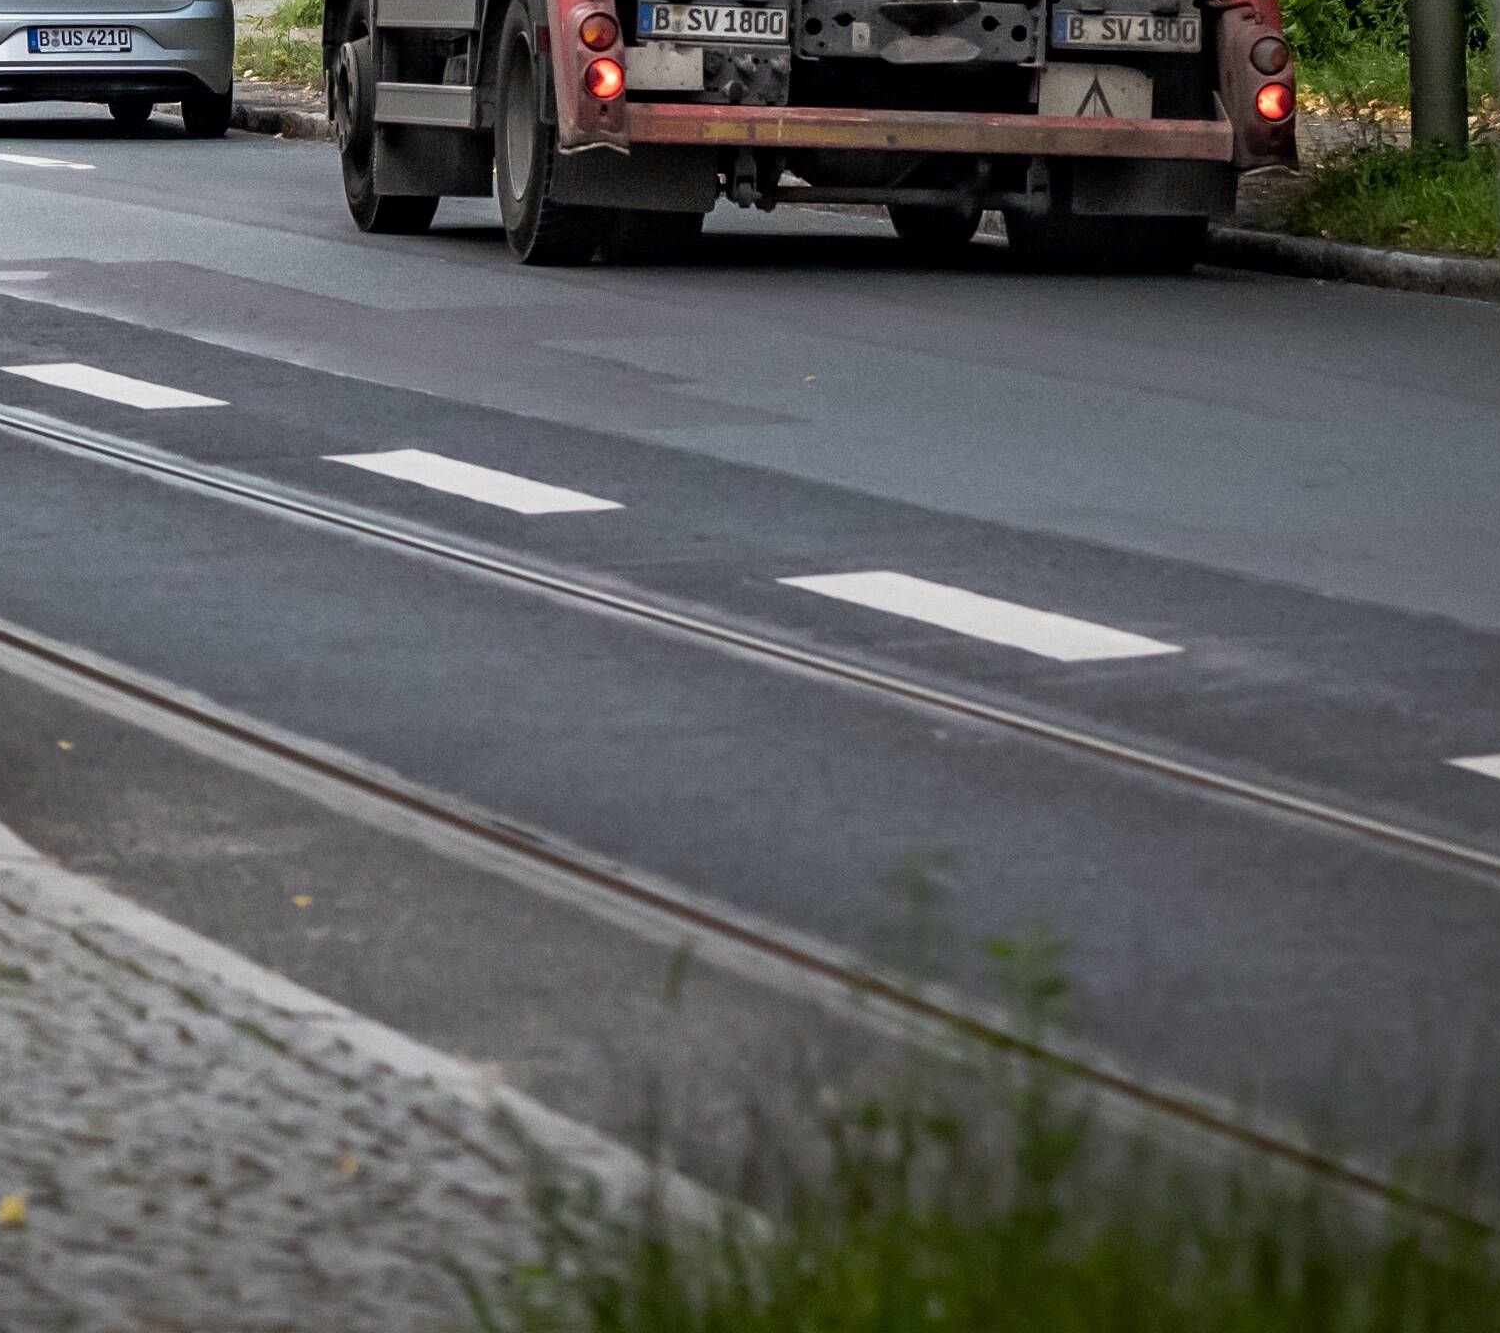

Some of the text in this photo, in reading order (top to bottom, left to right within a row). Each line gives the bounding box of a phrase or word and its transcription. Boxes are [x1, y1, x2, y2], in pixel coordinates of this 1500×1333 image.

[656, 7, 783, 34] B SV 1800
[1070, 17, 1196, 43] B SV 1800
[39, 30, 128, 46] B US 4210
